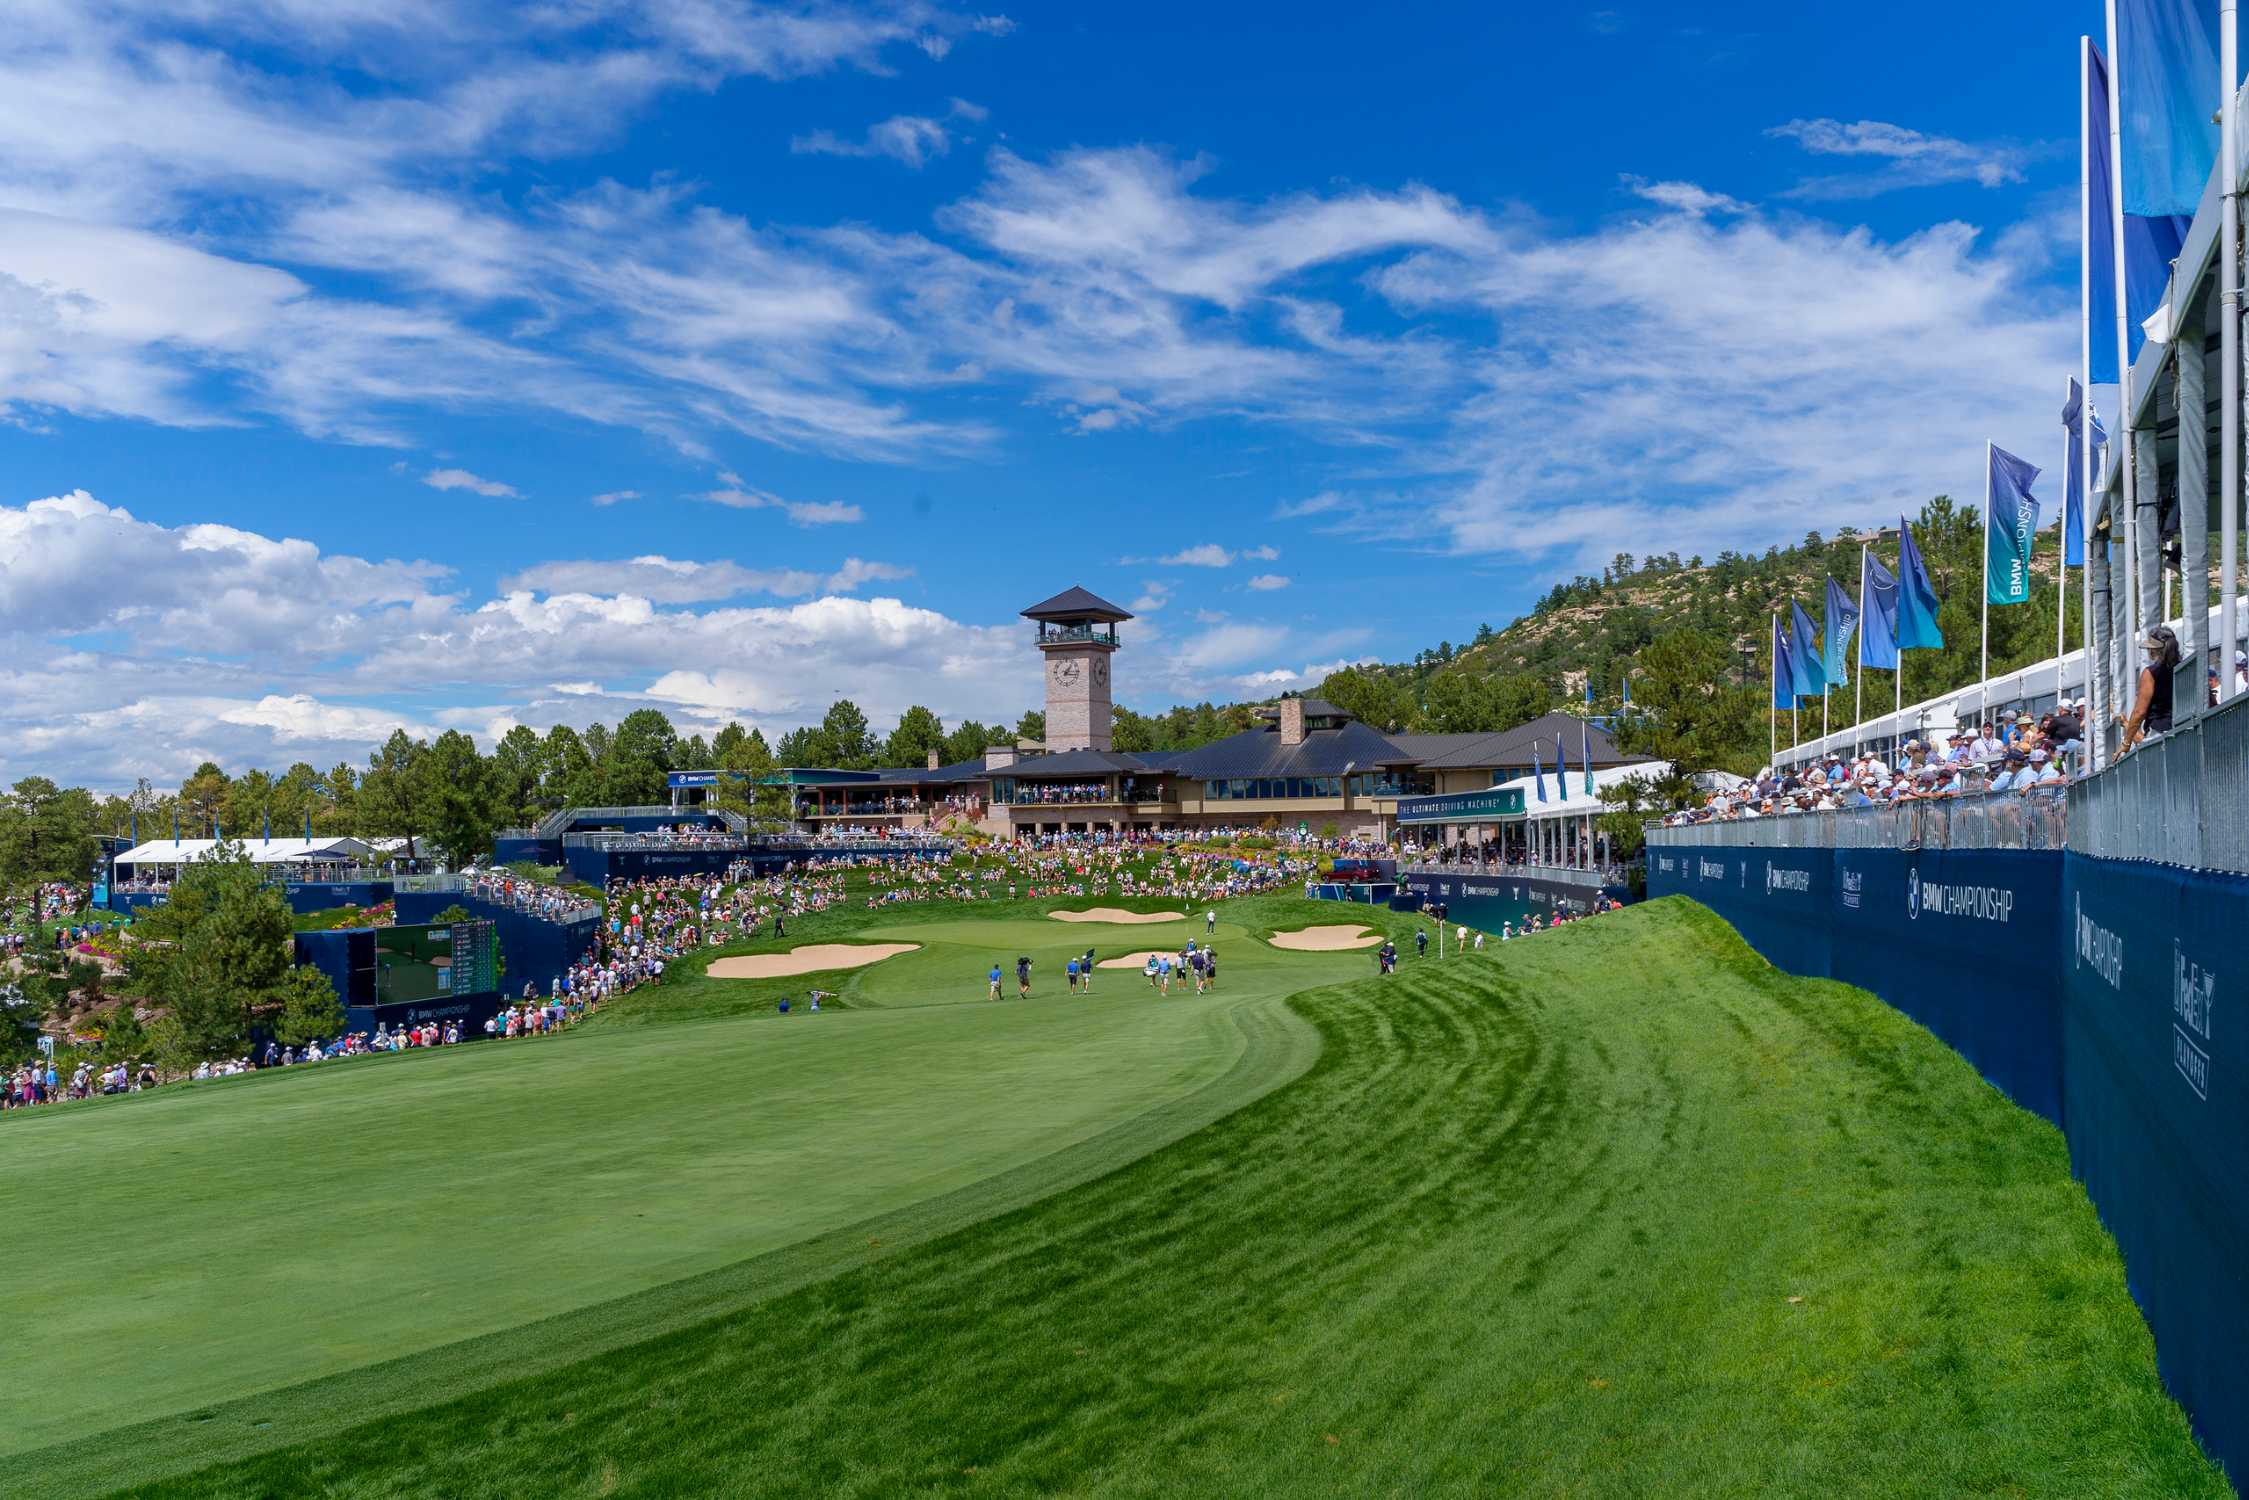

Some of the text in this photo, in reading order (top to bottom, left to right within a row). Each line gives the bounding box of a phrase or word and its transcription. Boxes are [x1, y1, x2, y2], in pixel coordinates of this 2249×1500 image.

[2010, 558, 2023, 596] BMW
[1400, 805, 1410, 814] THE
[1412, 803, 1439, 813] ULTIMATE
[1441, 801, 1464, 811] DRIVING
[1922, 882, 2013, 922] BMW CHAMPIONSHIP
